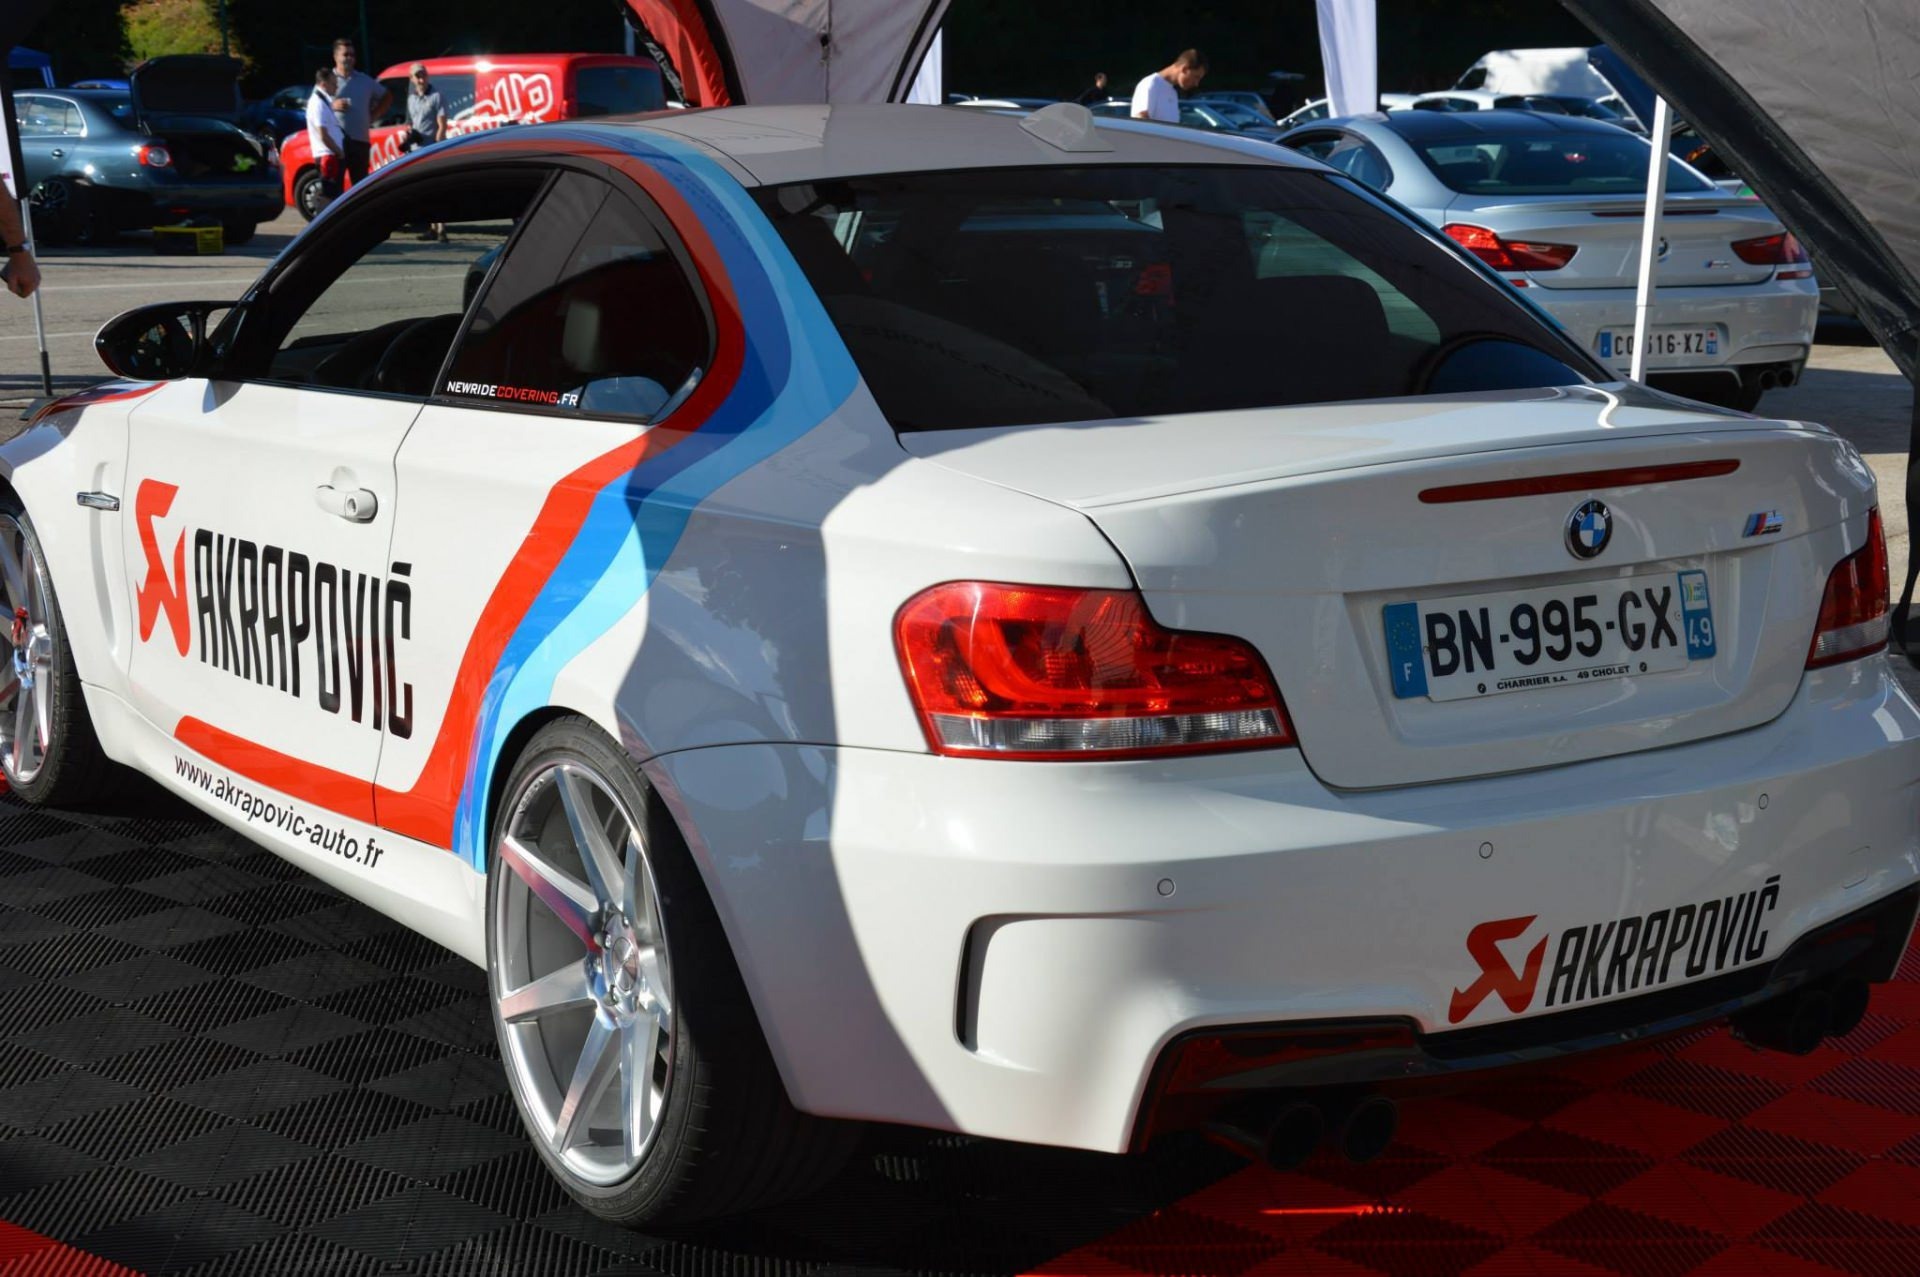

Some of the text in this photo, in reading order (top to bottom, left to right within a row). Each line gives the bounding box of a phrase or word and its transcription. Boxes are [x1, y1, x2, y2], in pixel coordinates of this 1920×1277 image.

[447, 381, 579, 406] NEWRIDECOVERING.FR
[1425, 586, 1678, 677] BN-995-GX
[1688, 616, 1714, 648] 49
[1403, 662, 1413, 681] F
[1497, 676, 1550, 690] CHARRIER
[1577, 671, 1589, 679] 49
[1592, 665, 1630, 677] CHOLET
[175, 755, 384, 868] www.akrapovic-auto.fr
